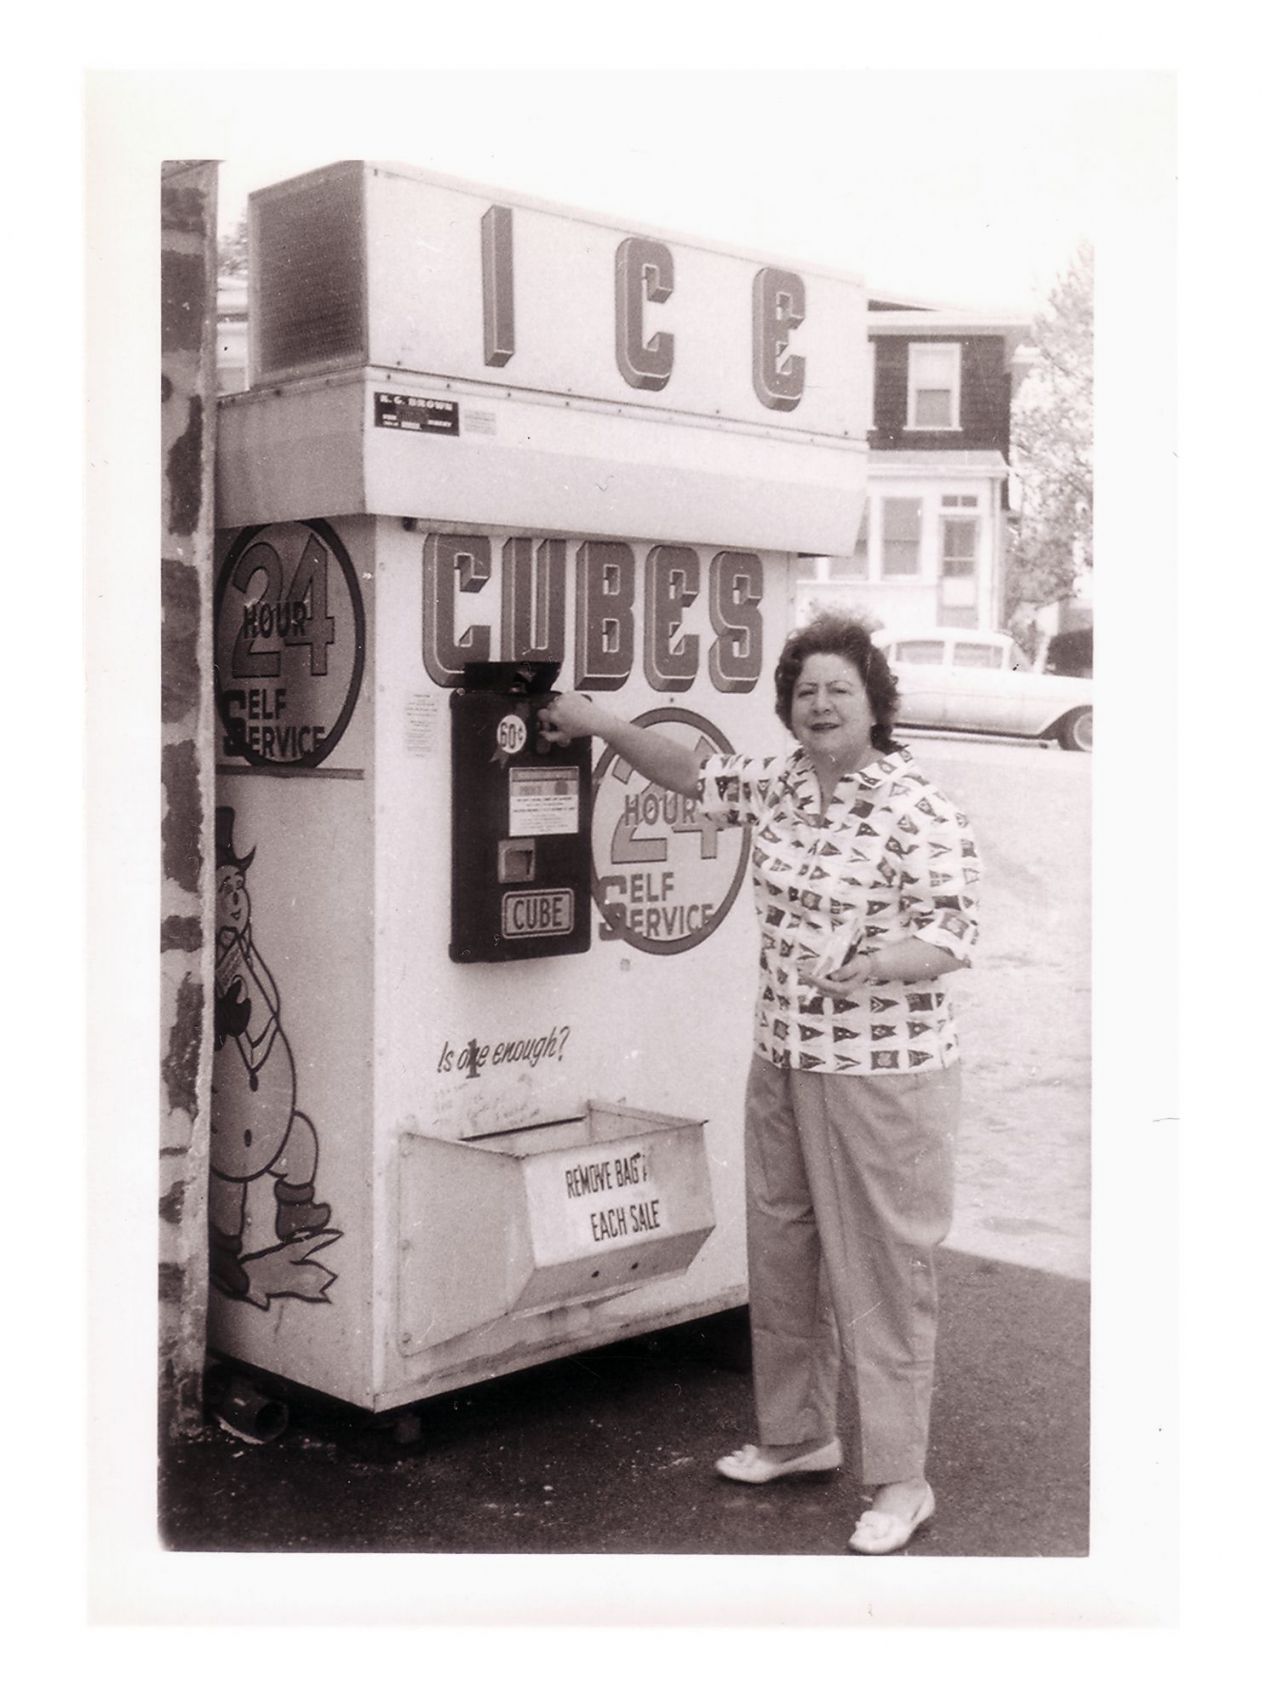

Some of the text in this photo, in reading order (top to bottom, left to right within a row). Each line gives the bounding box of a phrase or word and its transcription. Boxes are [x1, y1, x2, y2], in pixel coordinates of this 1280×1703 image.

[481, 204, 807, 412] ICE
[408, 397, 453, 411] BROWN
[232, 533, 335, 679] 24
[243, 601, 308, 639] HOUR
[422, 533, 763, 693] CUBES
[500, 721, 523, 749] 60¢
[624, 793, 696, 826] HOUR
[512, 896, 564, 931] CUBE
[436, 1041, 454, 1073] Is
[492, 1025, 571, 1068] enough?
[565, 1161, 613, 1199] REMOVE
[614, 1152, 641, 1188] BAG
[590, 1198, 661, 1242] EACH SALE
